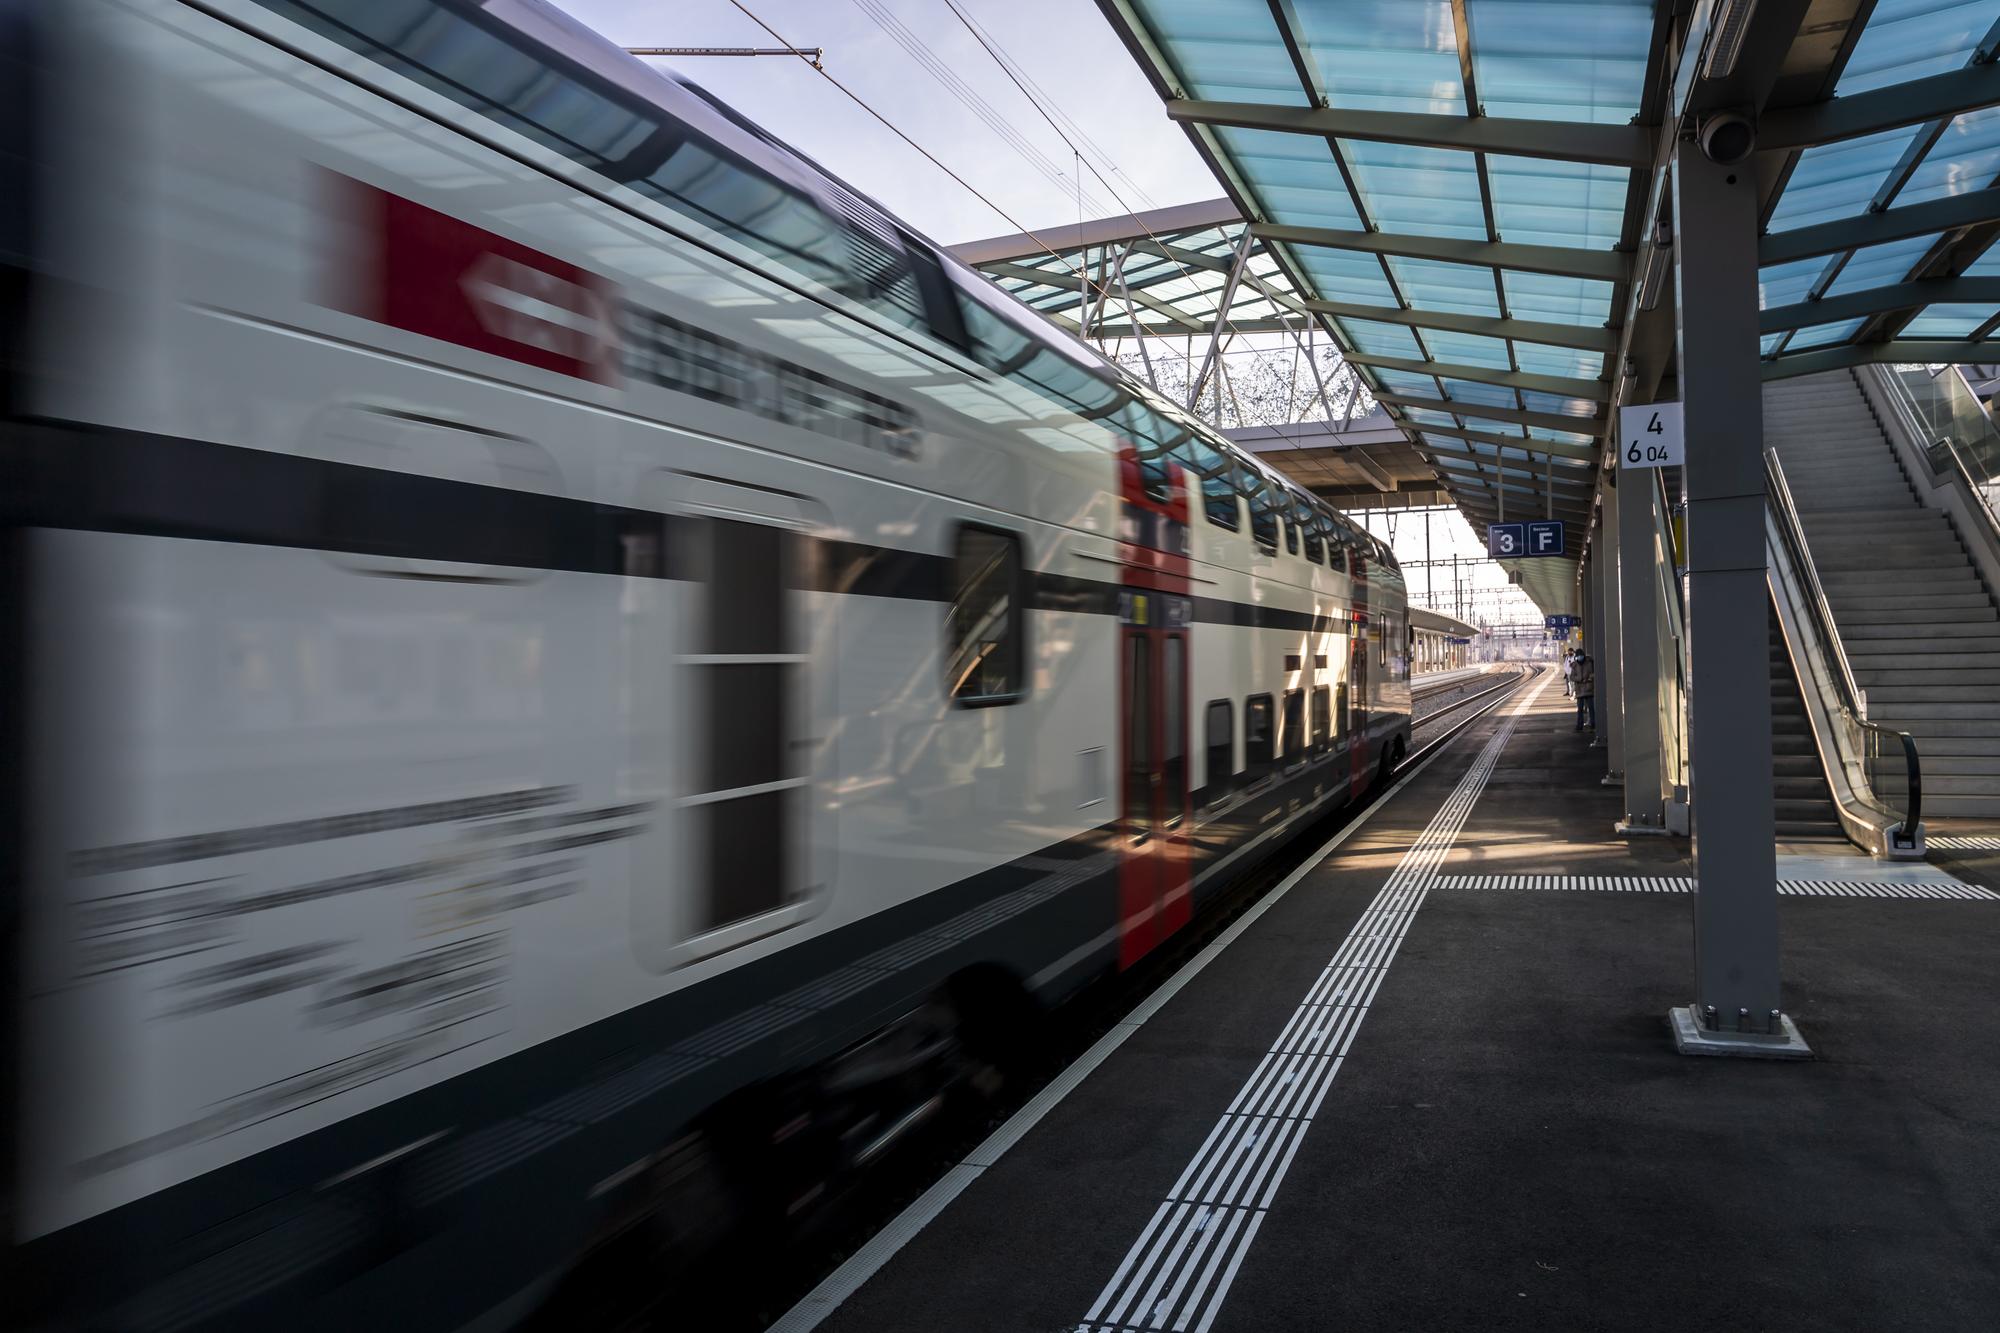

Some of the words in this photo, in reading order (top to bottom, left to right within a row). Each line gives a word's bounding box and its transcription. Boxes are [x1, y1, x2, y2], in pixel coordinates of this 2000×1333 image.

[1647, 412, 1663, 435] 4
[1627, 440, 1642, 463] 6
[1647, 445, 1668, 462] 04
[1500, 533, 1514, 553] 3
[1539, 532, 1553, 551] F
